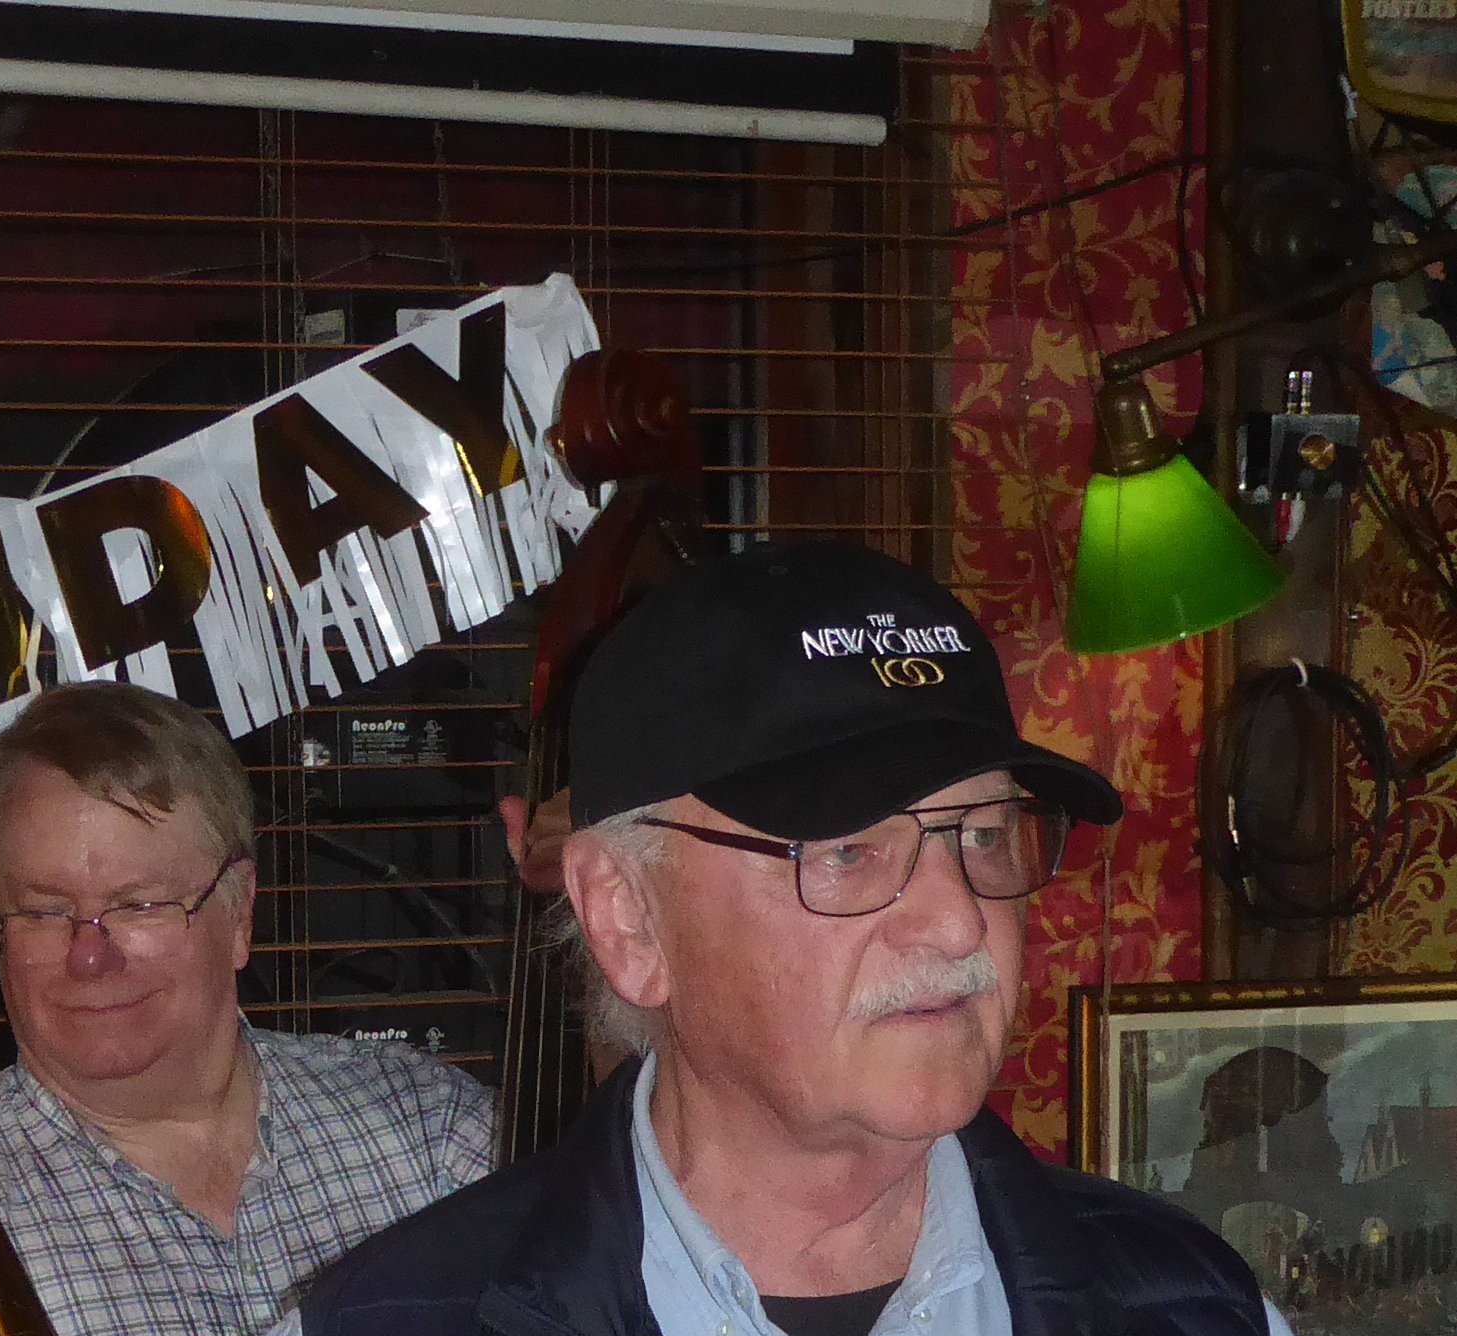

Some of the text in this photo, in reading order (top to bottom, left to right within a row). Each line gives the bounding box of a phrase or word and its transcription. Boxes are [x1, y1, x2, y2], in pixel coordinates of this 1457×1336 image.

[866, 613, 897, 628] THE
[801, 626, 972, 660] NEW YORKER
[870, 656, 945, 688] 100
[352, 719, 406, 732] NeonPro
[355, 1030, 408, 1041] NeonPro
